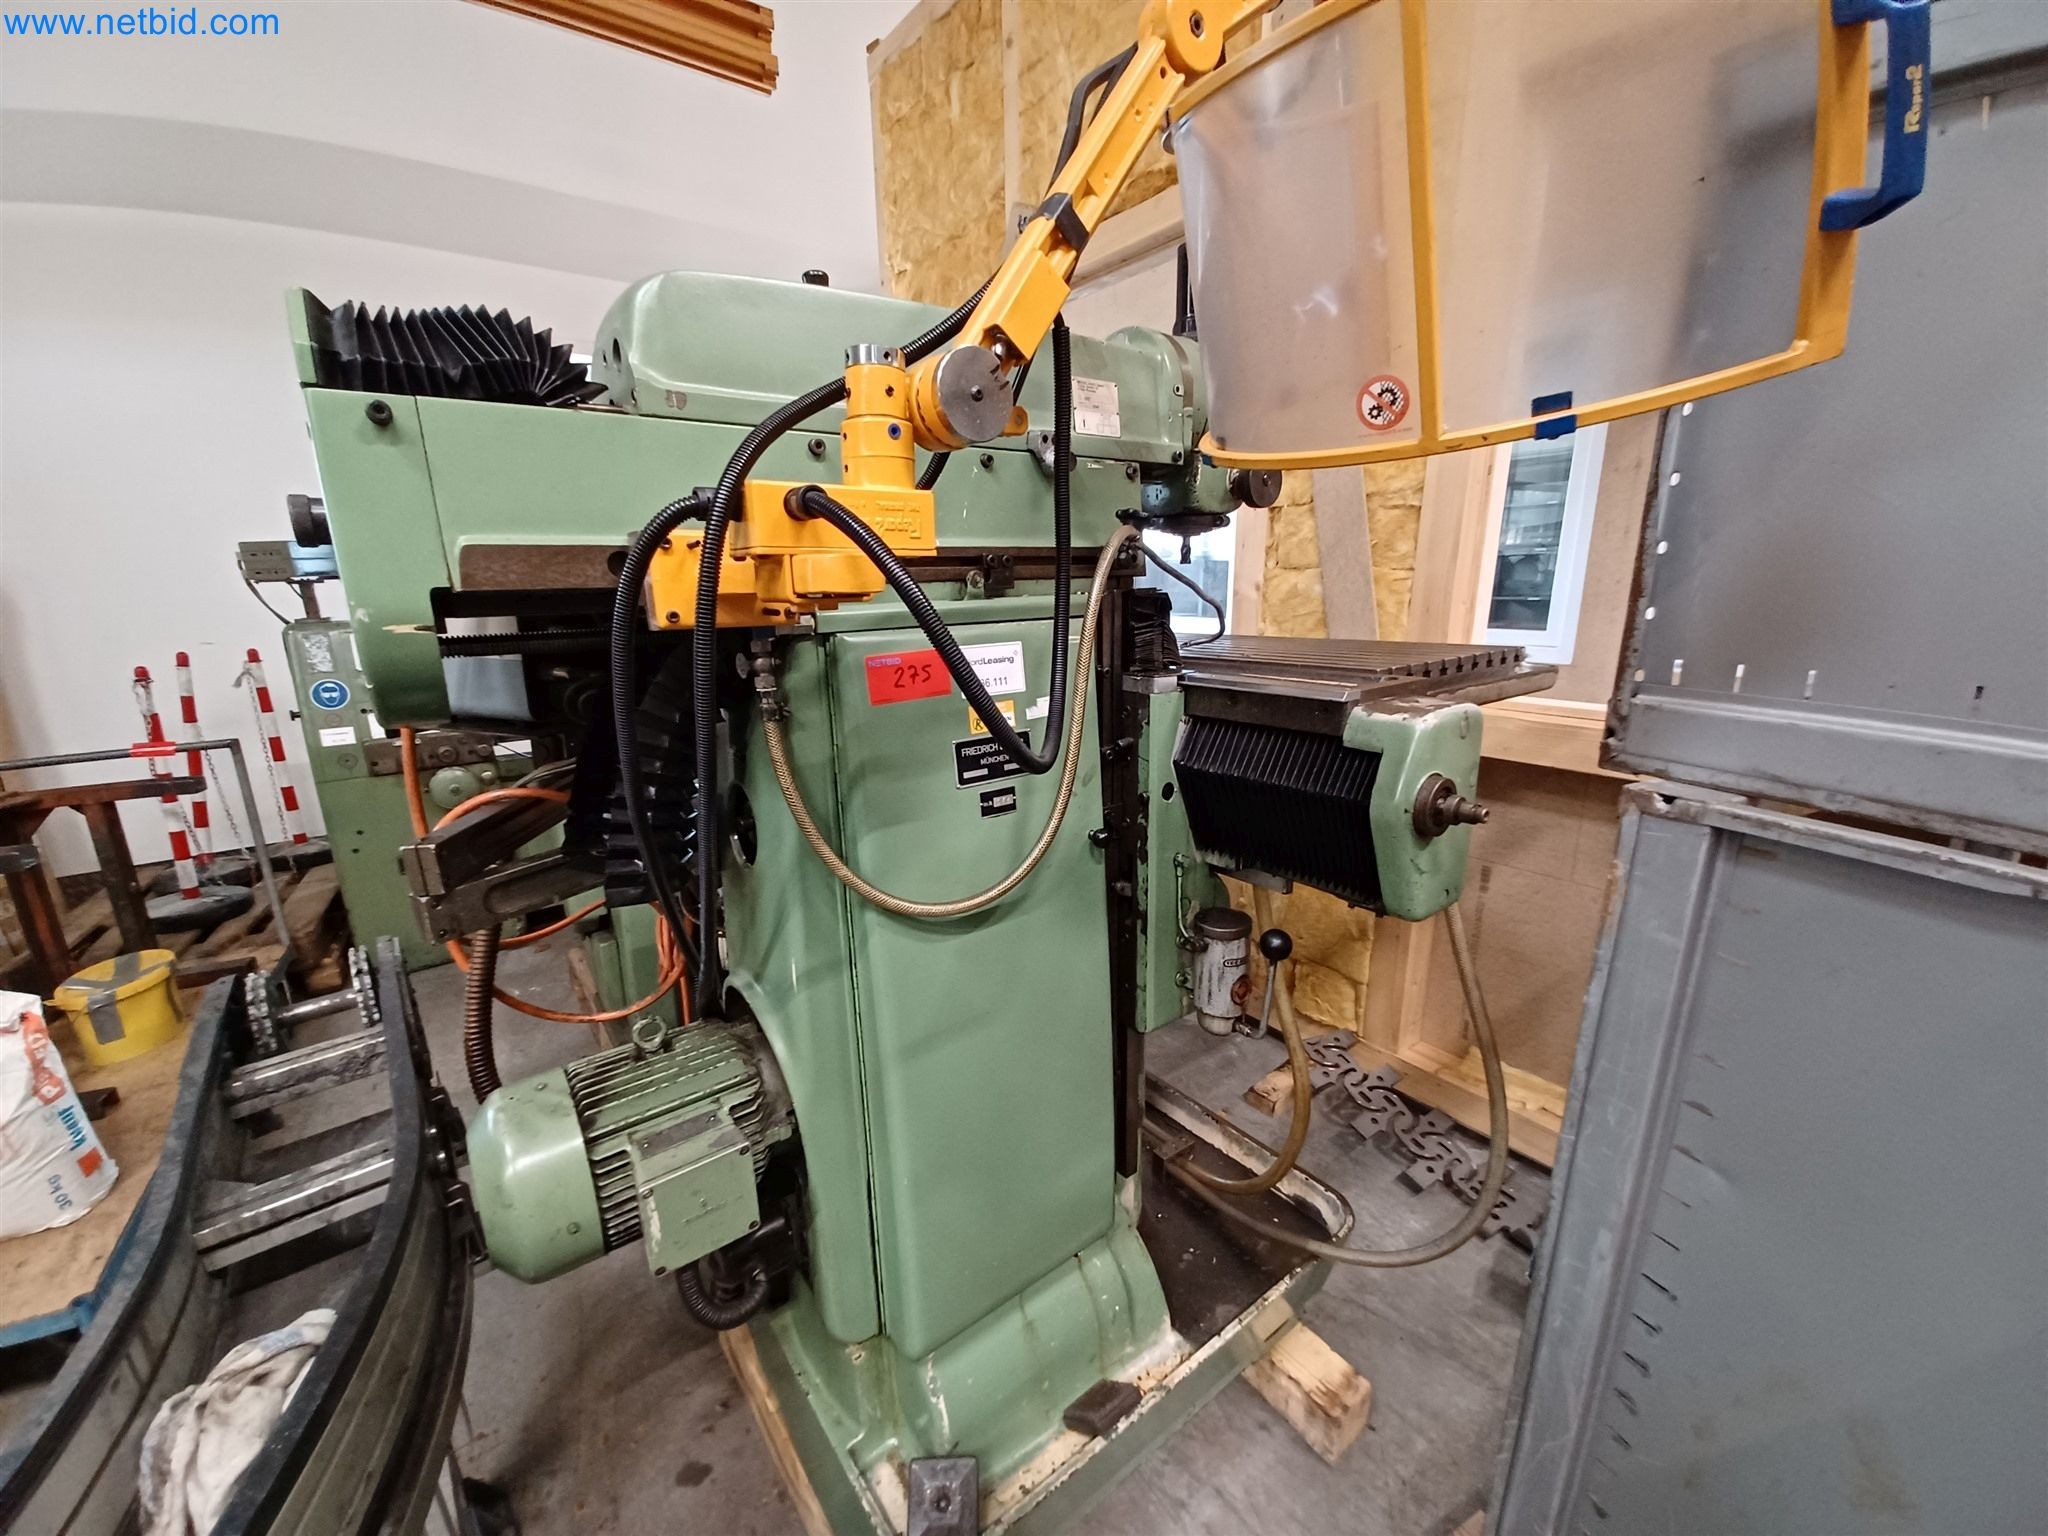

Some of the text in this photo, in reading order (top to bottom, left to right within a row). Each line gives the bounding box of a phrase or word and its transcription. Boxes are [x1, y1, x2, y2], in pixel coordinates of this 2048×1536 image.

[969, 656, 1015, 666] ordLeasing
[893, 663, 932, 688] 275
[961, 742, 999, 758] FRIEDRICH
